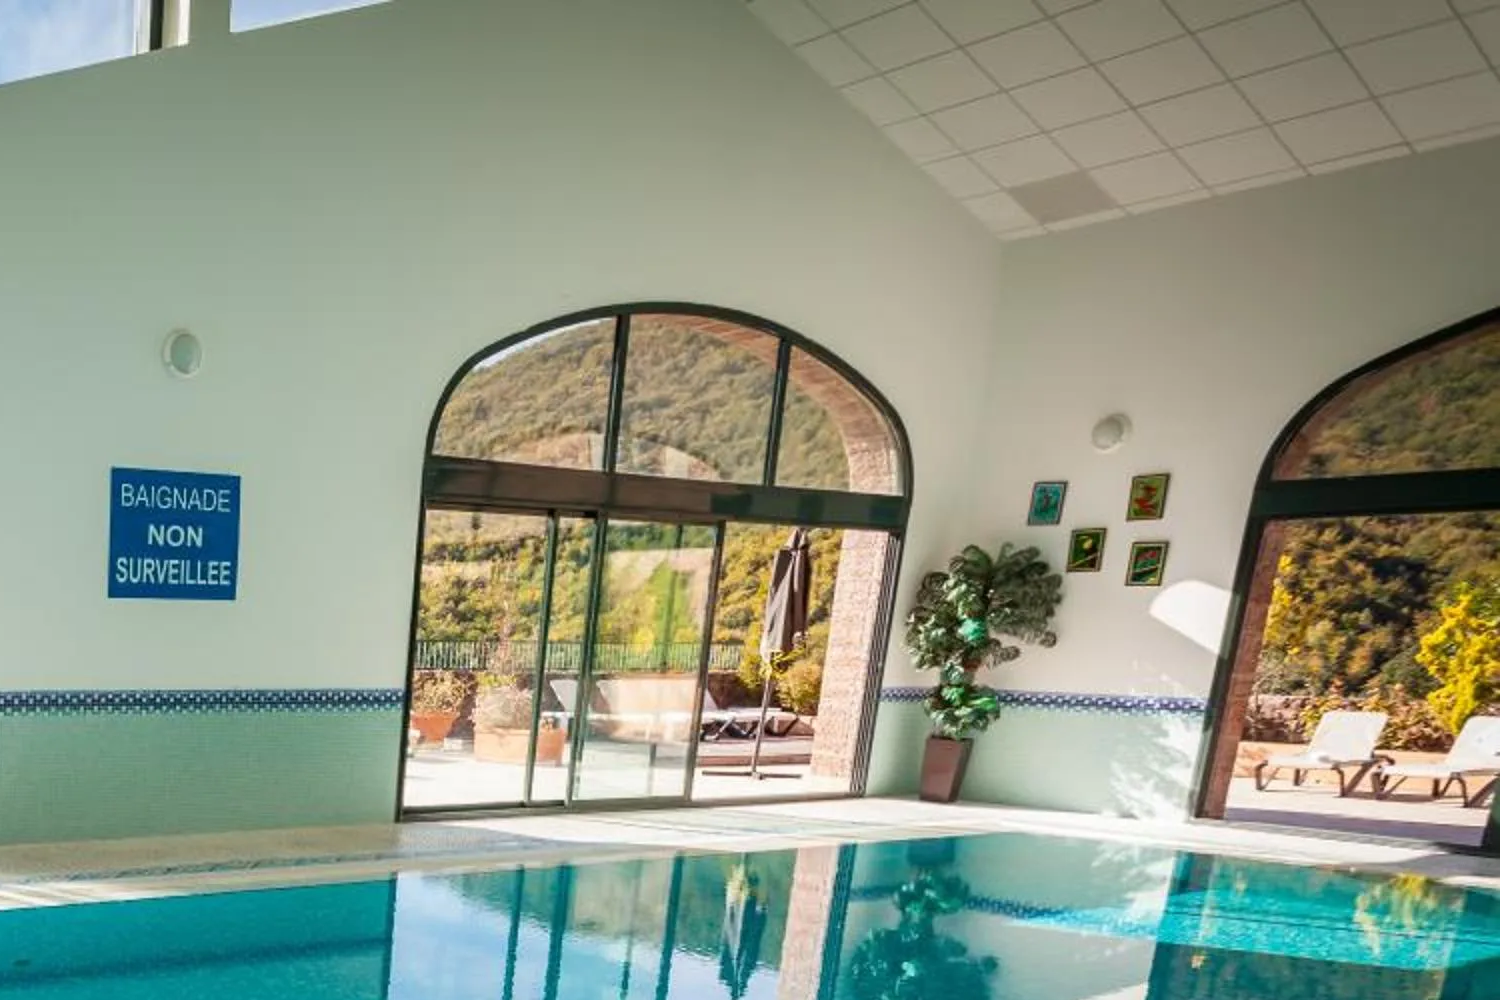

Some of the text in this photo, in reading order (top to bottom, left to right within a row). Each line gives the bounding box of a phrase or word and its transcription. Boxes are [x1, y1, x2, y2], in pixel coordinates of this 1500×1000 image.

[120, 483, 231, 513] BAIGNADE
[147, 524, 203, 547] NON
[115, 557, 231, 586] SURVEILLEE
